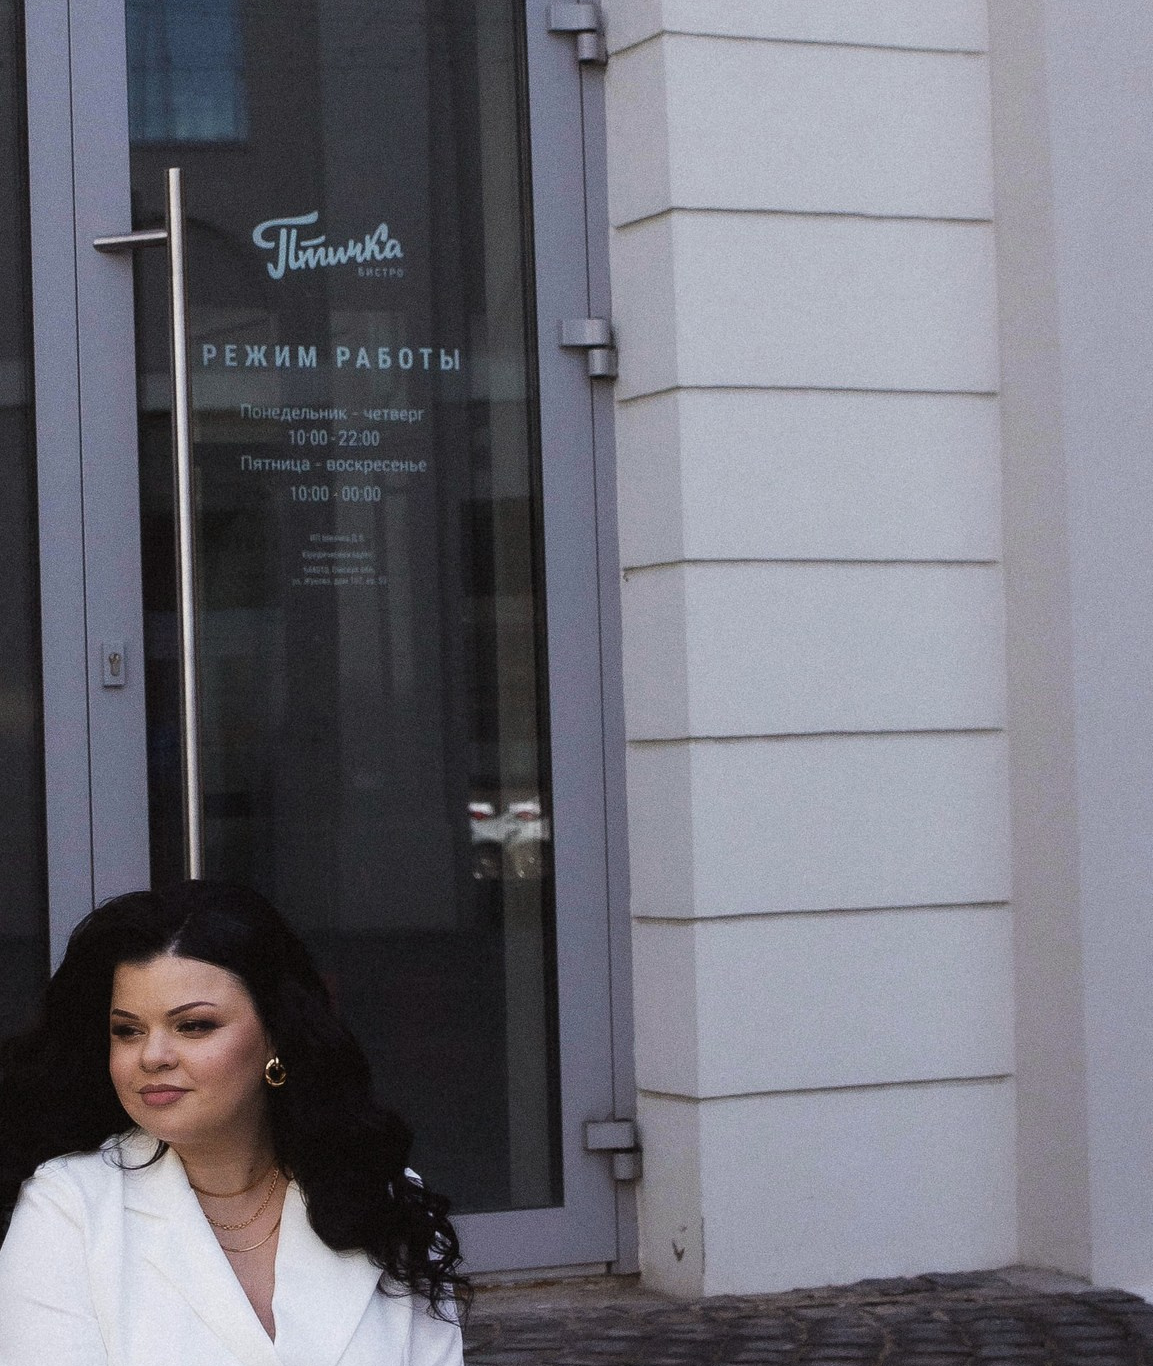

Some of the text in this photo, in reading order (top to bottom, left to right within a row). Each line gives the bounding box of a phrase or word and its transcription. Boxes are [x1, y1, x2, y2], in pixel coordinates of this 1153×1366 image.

[252, 210, 404, 280] Птичка
[357, 266, 405, 278] БИСТРО
[202, 344, 461, 370] РЕЖИМ РАБОТЫ
[239, 403, 347, 422] Понедельник
[362, 408, 425, 424] четверг
[289, 429, 328, 446] 10:00
[338, 430, 380, 447] 22:00
[240, 455, 311, 473] Пятница
[326, 458, 428, 475] воскресенье
[291, 486, 329, 502] 10:00
[342, 486, 382, 502] 00:00
